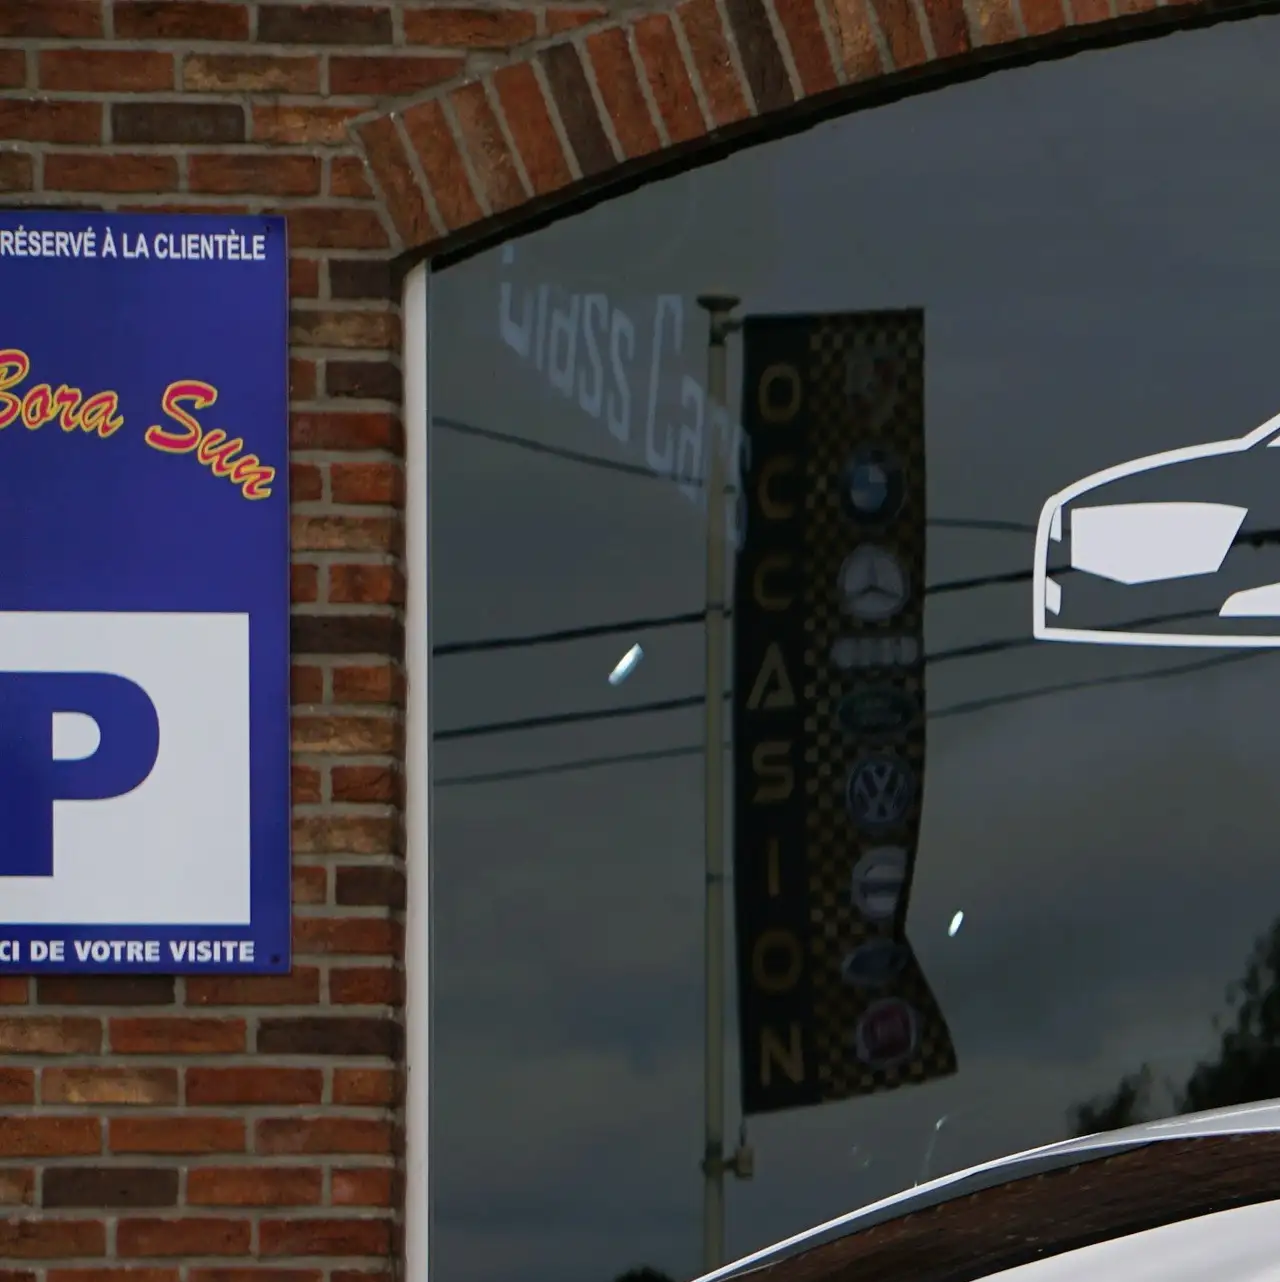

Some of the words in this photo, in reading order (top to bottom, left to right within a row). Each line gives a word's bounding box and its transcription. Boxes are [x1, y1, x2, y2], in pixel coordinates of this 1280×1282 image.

[0, 225, 97, 258] RÉSERVÉ
[102, 226, 117, 258] À
[122, 232, 150, 259] LA
[154, 228, 266, 261] CLIENTÈLE
[145, 379, 276, 500] Sun
[0, 671, 160, 877] P
[746, 362, 804, 1088] OCCASION
[30, 940, 65, 962] DE
[74, 940, 161, 962] VOTRE
[169, 940, 255, 962] VISITE
